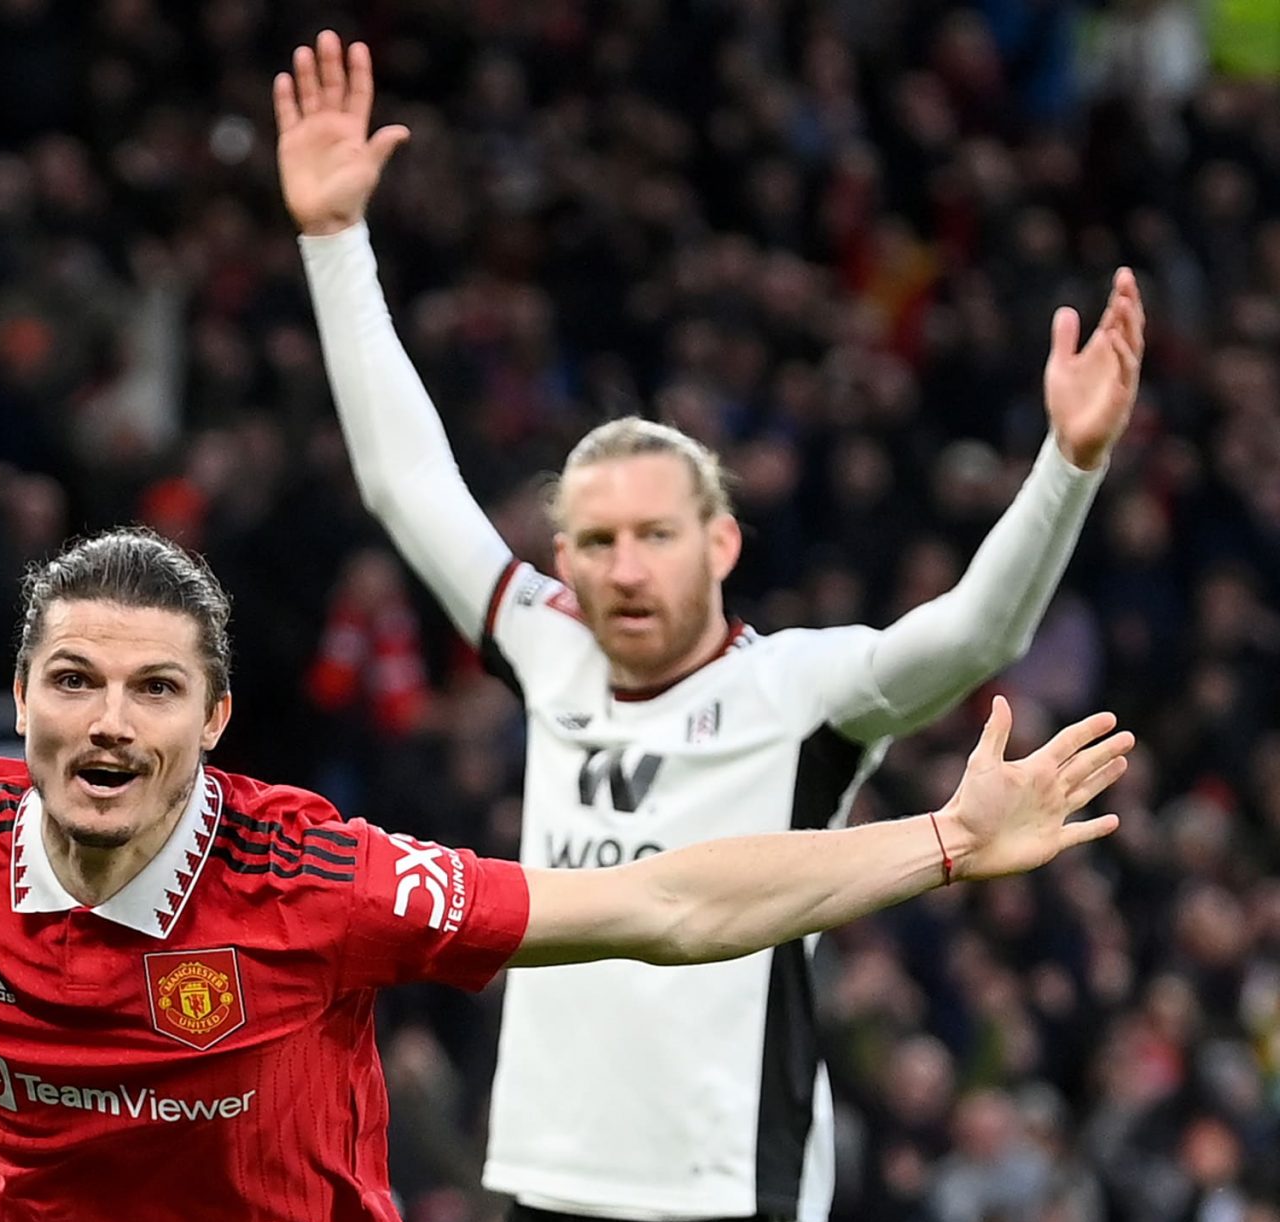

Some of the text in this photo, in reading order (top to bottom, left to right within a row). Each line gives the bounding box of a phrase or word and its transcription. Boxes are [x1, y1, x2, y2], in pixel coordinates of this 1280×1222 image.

[393, 833, 447, 930] DX
[443, 850, 466, 932] TECHNO
[164, 966, 224, 992] MANCHESTER
[179, 1014, 220, 1029] UNITED
[14, 1073, 256, 1122] TeamViewer
